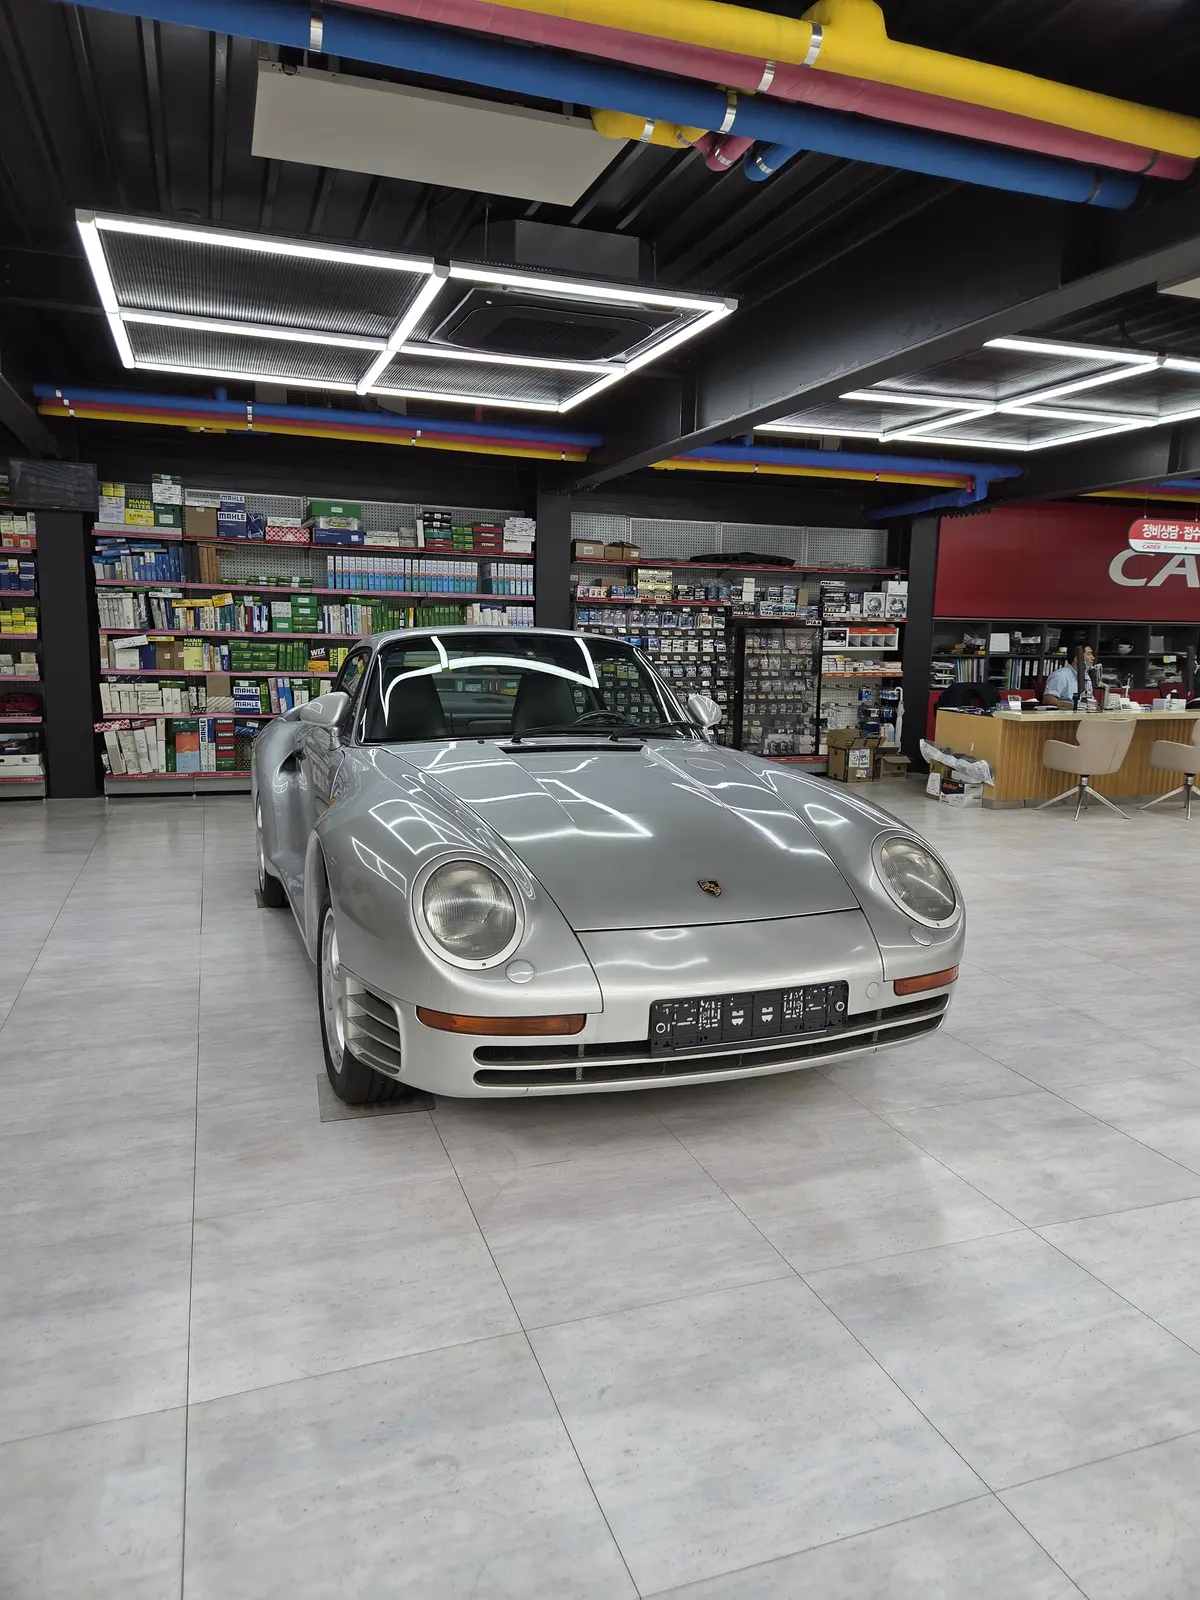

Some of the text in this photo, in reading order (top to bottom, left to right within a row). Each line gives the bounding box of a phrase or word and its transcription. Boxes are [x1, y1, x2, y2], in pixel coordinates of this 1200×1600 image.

[218, 513, 246, 521] MAHLE
[1108, 548, 1200, 588] CA
[310, 647, 326, 656] WIX
